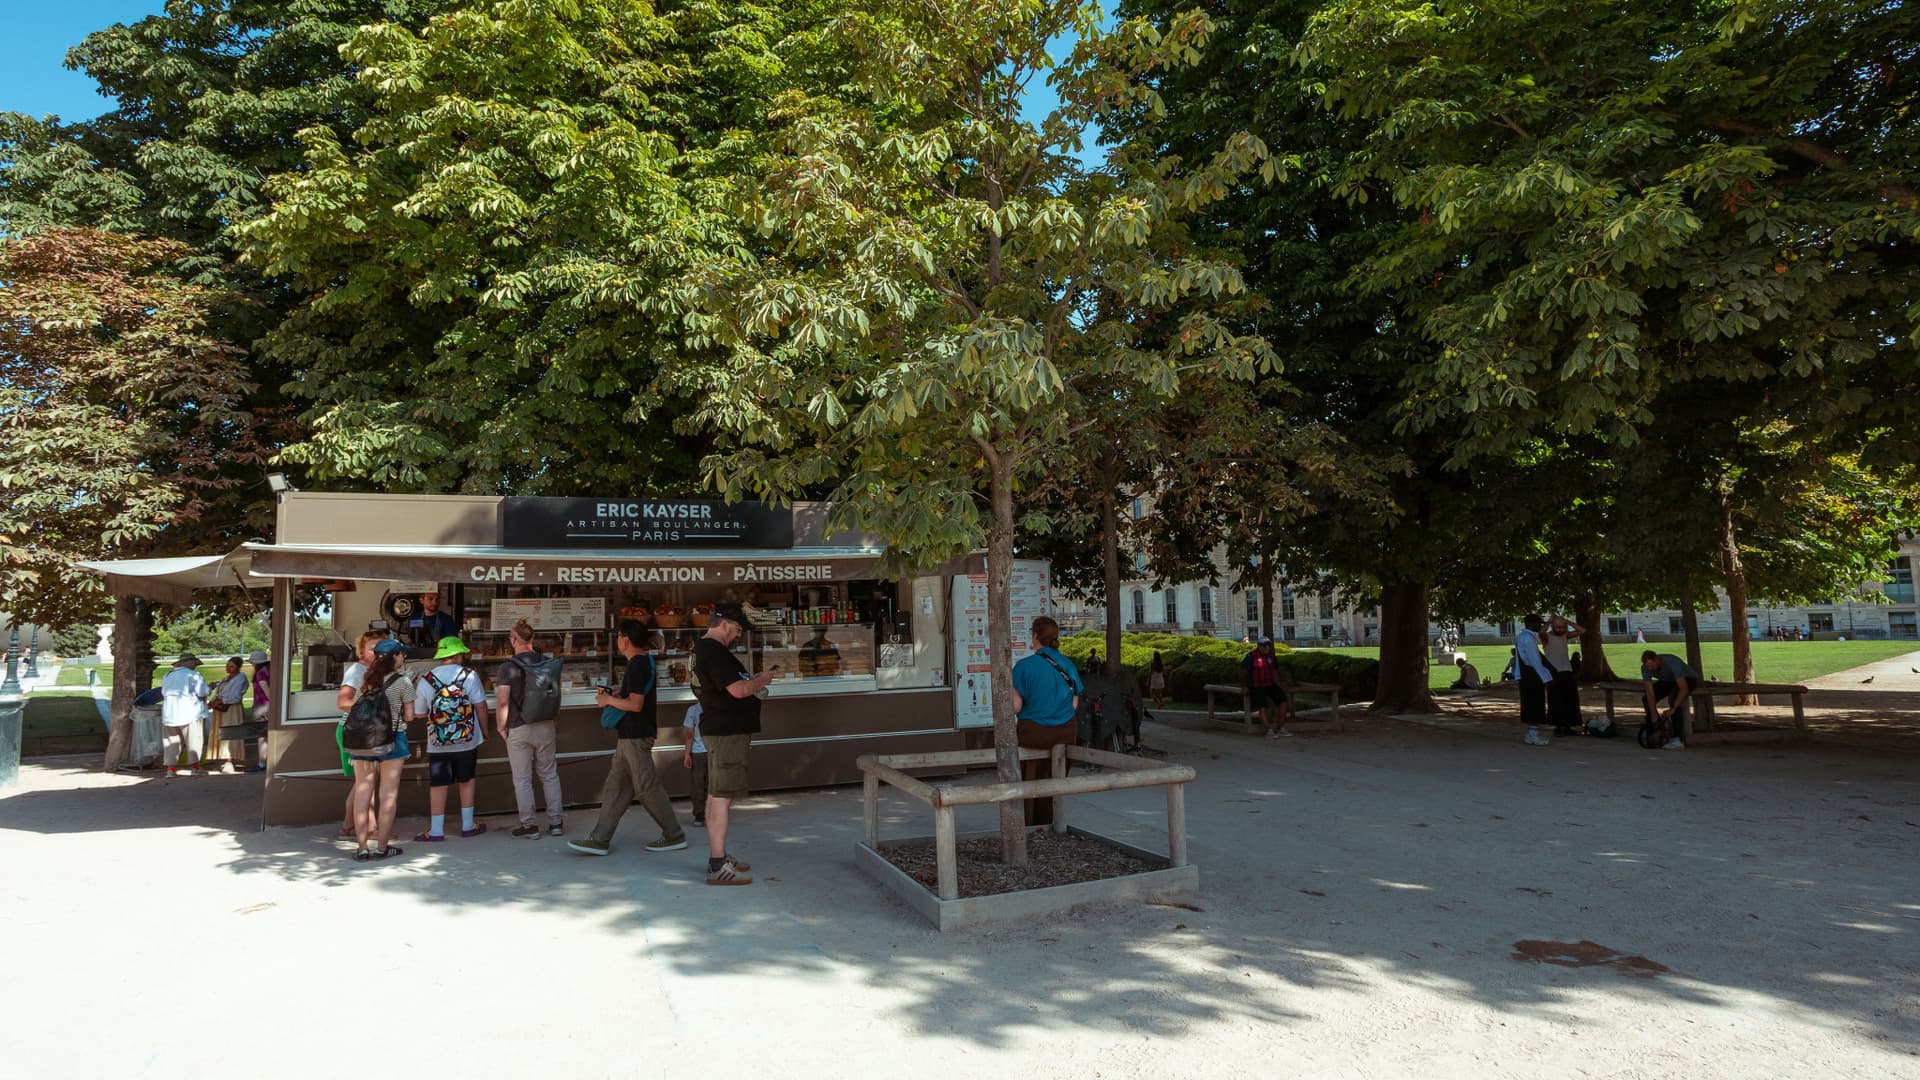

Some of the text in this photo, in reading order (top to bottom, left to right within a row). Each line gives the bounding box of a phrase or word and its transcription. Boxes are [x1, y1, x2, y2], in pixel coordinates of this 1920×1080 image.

[596, 503, 711, 519] ERIC KAYSER
[567, 520, 640, 528] ARTISAN
[632, 531, 679, 541] PARIS
[470, 562, 832, 583] CAFÉ RESTAURATION PÂTISSERIE
